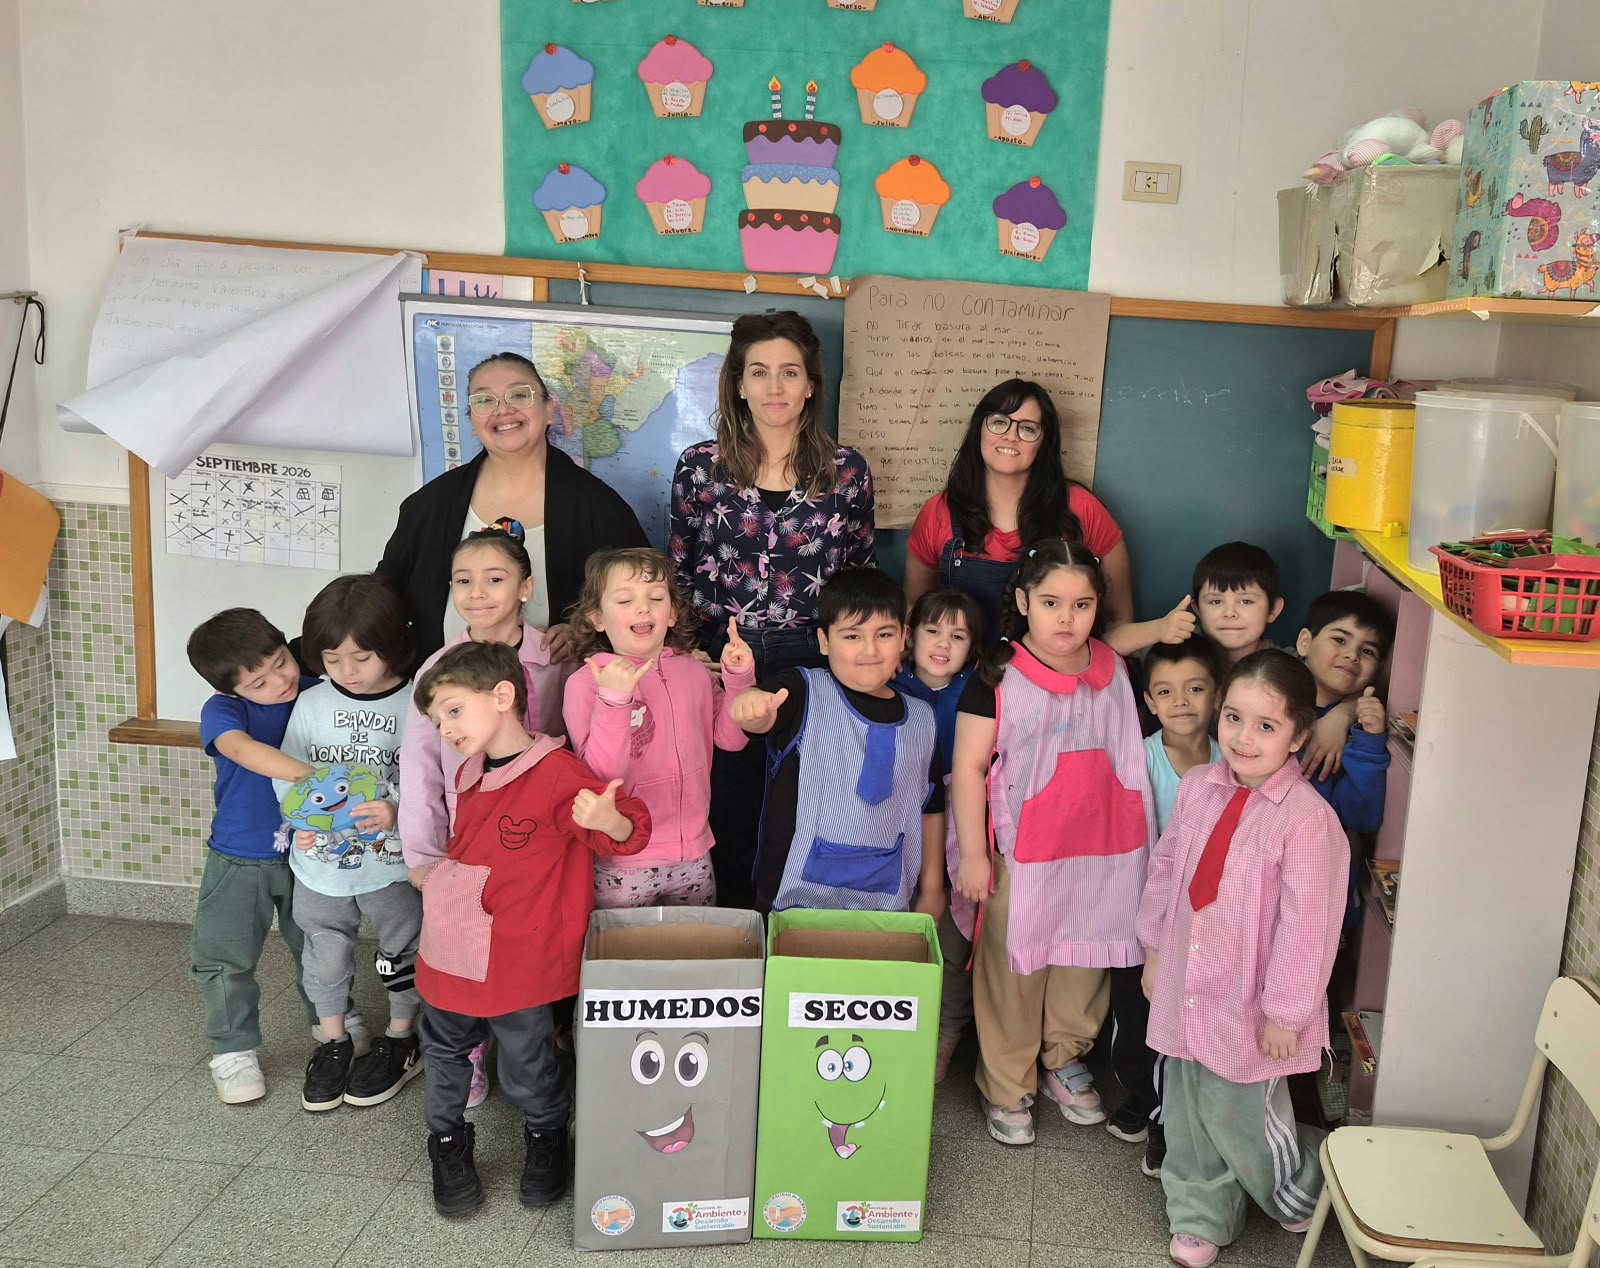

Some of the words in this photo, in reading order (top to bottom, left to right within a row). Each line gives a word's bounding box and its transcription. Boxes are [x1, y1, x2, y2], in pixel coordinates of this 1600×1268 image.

[195, 455, 278, 476] SEPTIEMBRE
[281, 465, 312, 478] 2026
[335, 710, 397, 734] BANDA
[351, 732, 368, 743] DE
[585, 996, 761, 1022] HUMEDOS
[804, 1000, 913, 1021] SECOS
[695, 1209, 742, 1219] Ambiente
[743, 1209, 748, 1217] y
[868, 1209, 913, 1219] Ambiente
[914, 1211, 919, 1219] y
[694, 1217, 729, 1225] Desarrollo
[867, 1217, 901, 1225] Desarrollo
